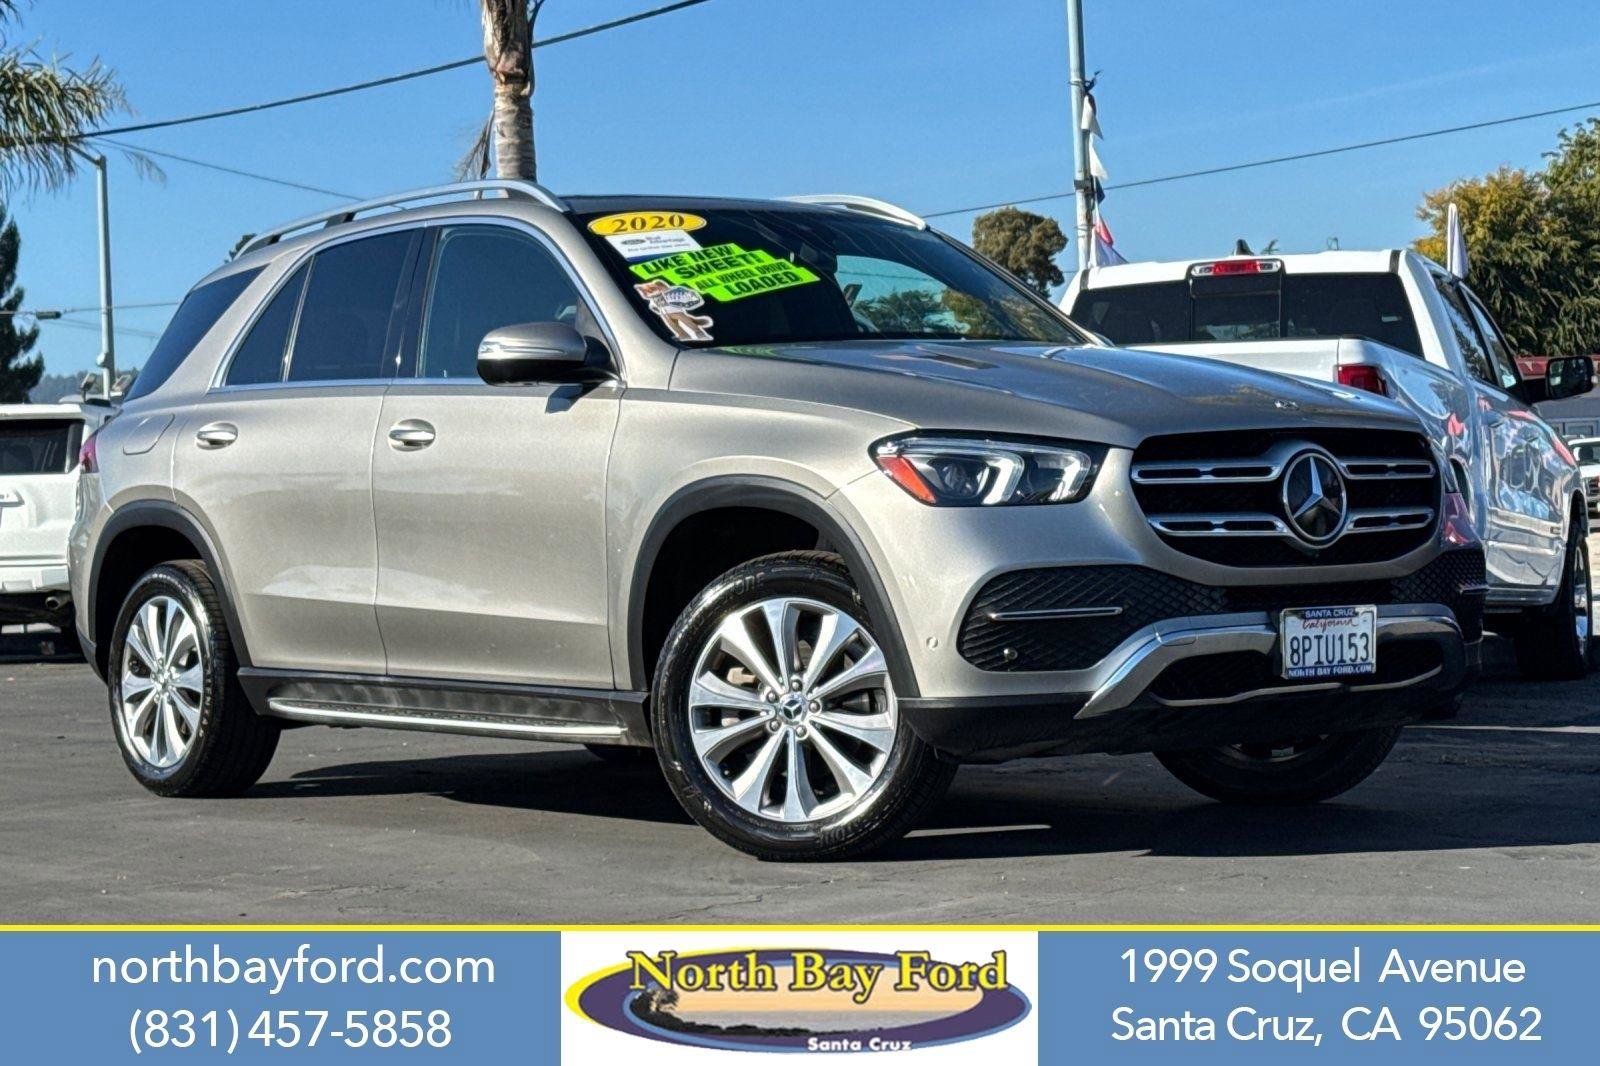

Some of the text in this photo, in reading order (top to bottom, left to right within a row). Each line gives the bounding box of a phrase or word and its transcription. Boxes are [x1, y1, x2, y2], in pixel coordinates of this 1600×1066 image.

[611, 214, 685, 234] 2020
[641, 254, 687, 275] LIKE
[687, 245, 734, 263] NEW
[674, 252, 766, 279] SWEET!
[716, 268, 757, 283] WHEEL
[754, 261, 790, 275] DRIVE
[723, 271, 803, 296] LOADED
[1304, 608, 1355, 618] SANTA CRUZ
[1302, 618, 1360, 633] California
[1289, 632, 1370, 666] 8PIU153
[1288, 668, 1315, 678] NORTH
[1316, 666, 1331, 677] BAY
